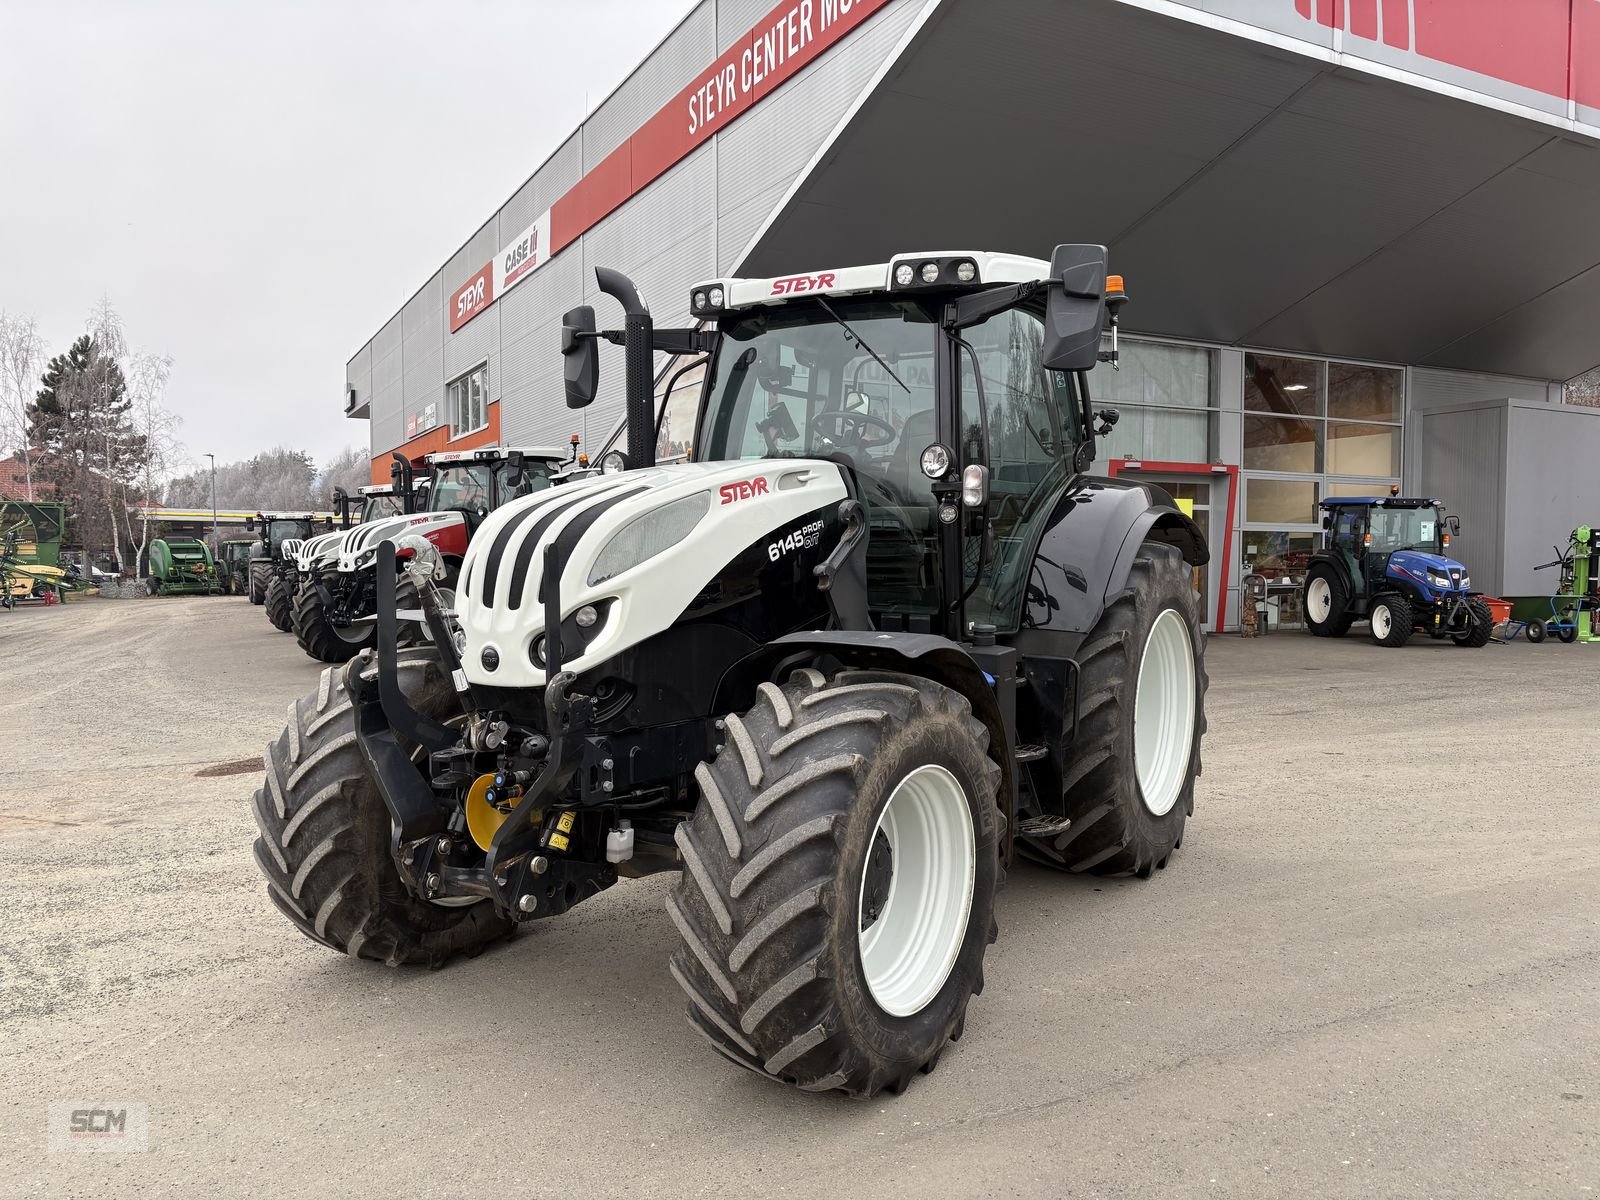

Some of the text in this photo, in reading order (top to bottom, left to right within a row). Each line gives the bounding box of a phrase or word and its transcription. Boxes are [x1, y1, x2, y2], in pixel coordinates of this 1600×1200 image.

[688, 63, 736, 134] STEYR
[741, 0, 813, 93] CENTER
[505, 238, 528, 273] CASE
[457, 276, 484, 318] STEYR
[770, 273, 836, 296] STEYR
[720, 476, 770, 505] STEYR
[410, 517, 429, 526] STEYR
[768, 520, 825, 562] 6145 PROFI
